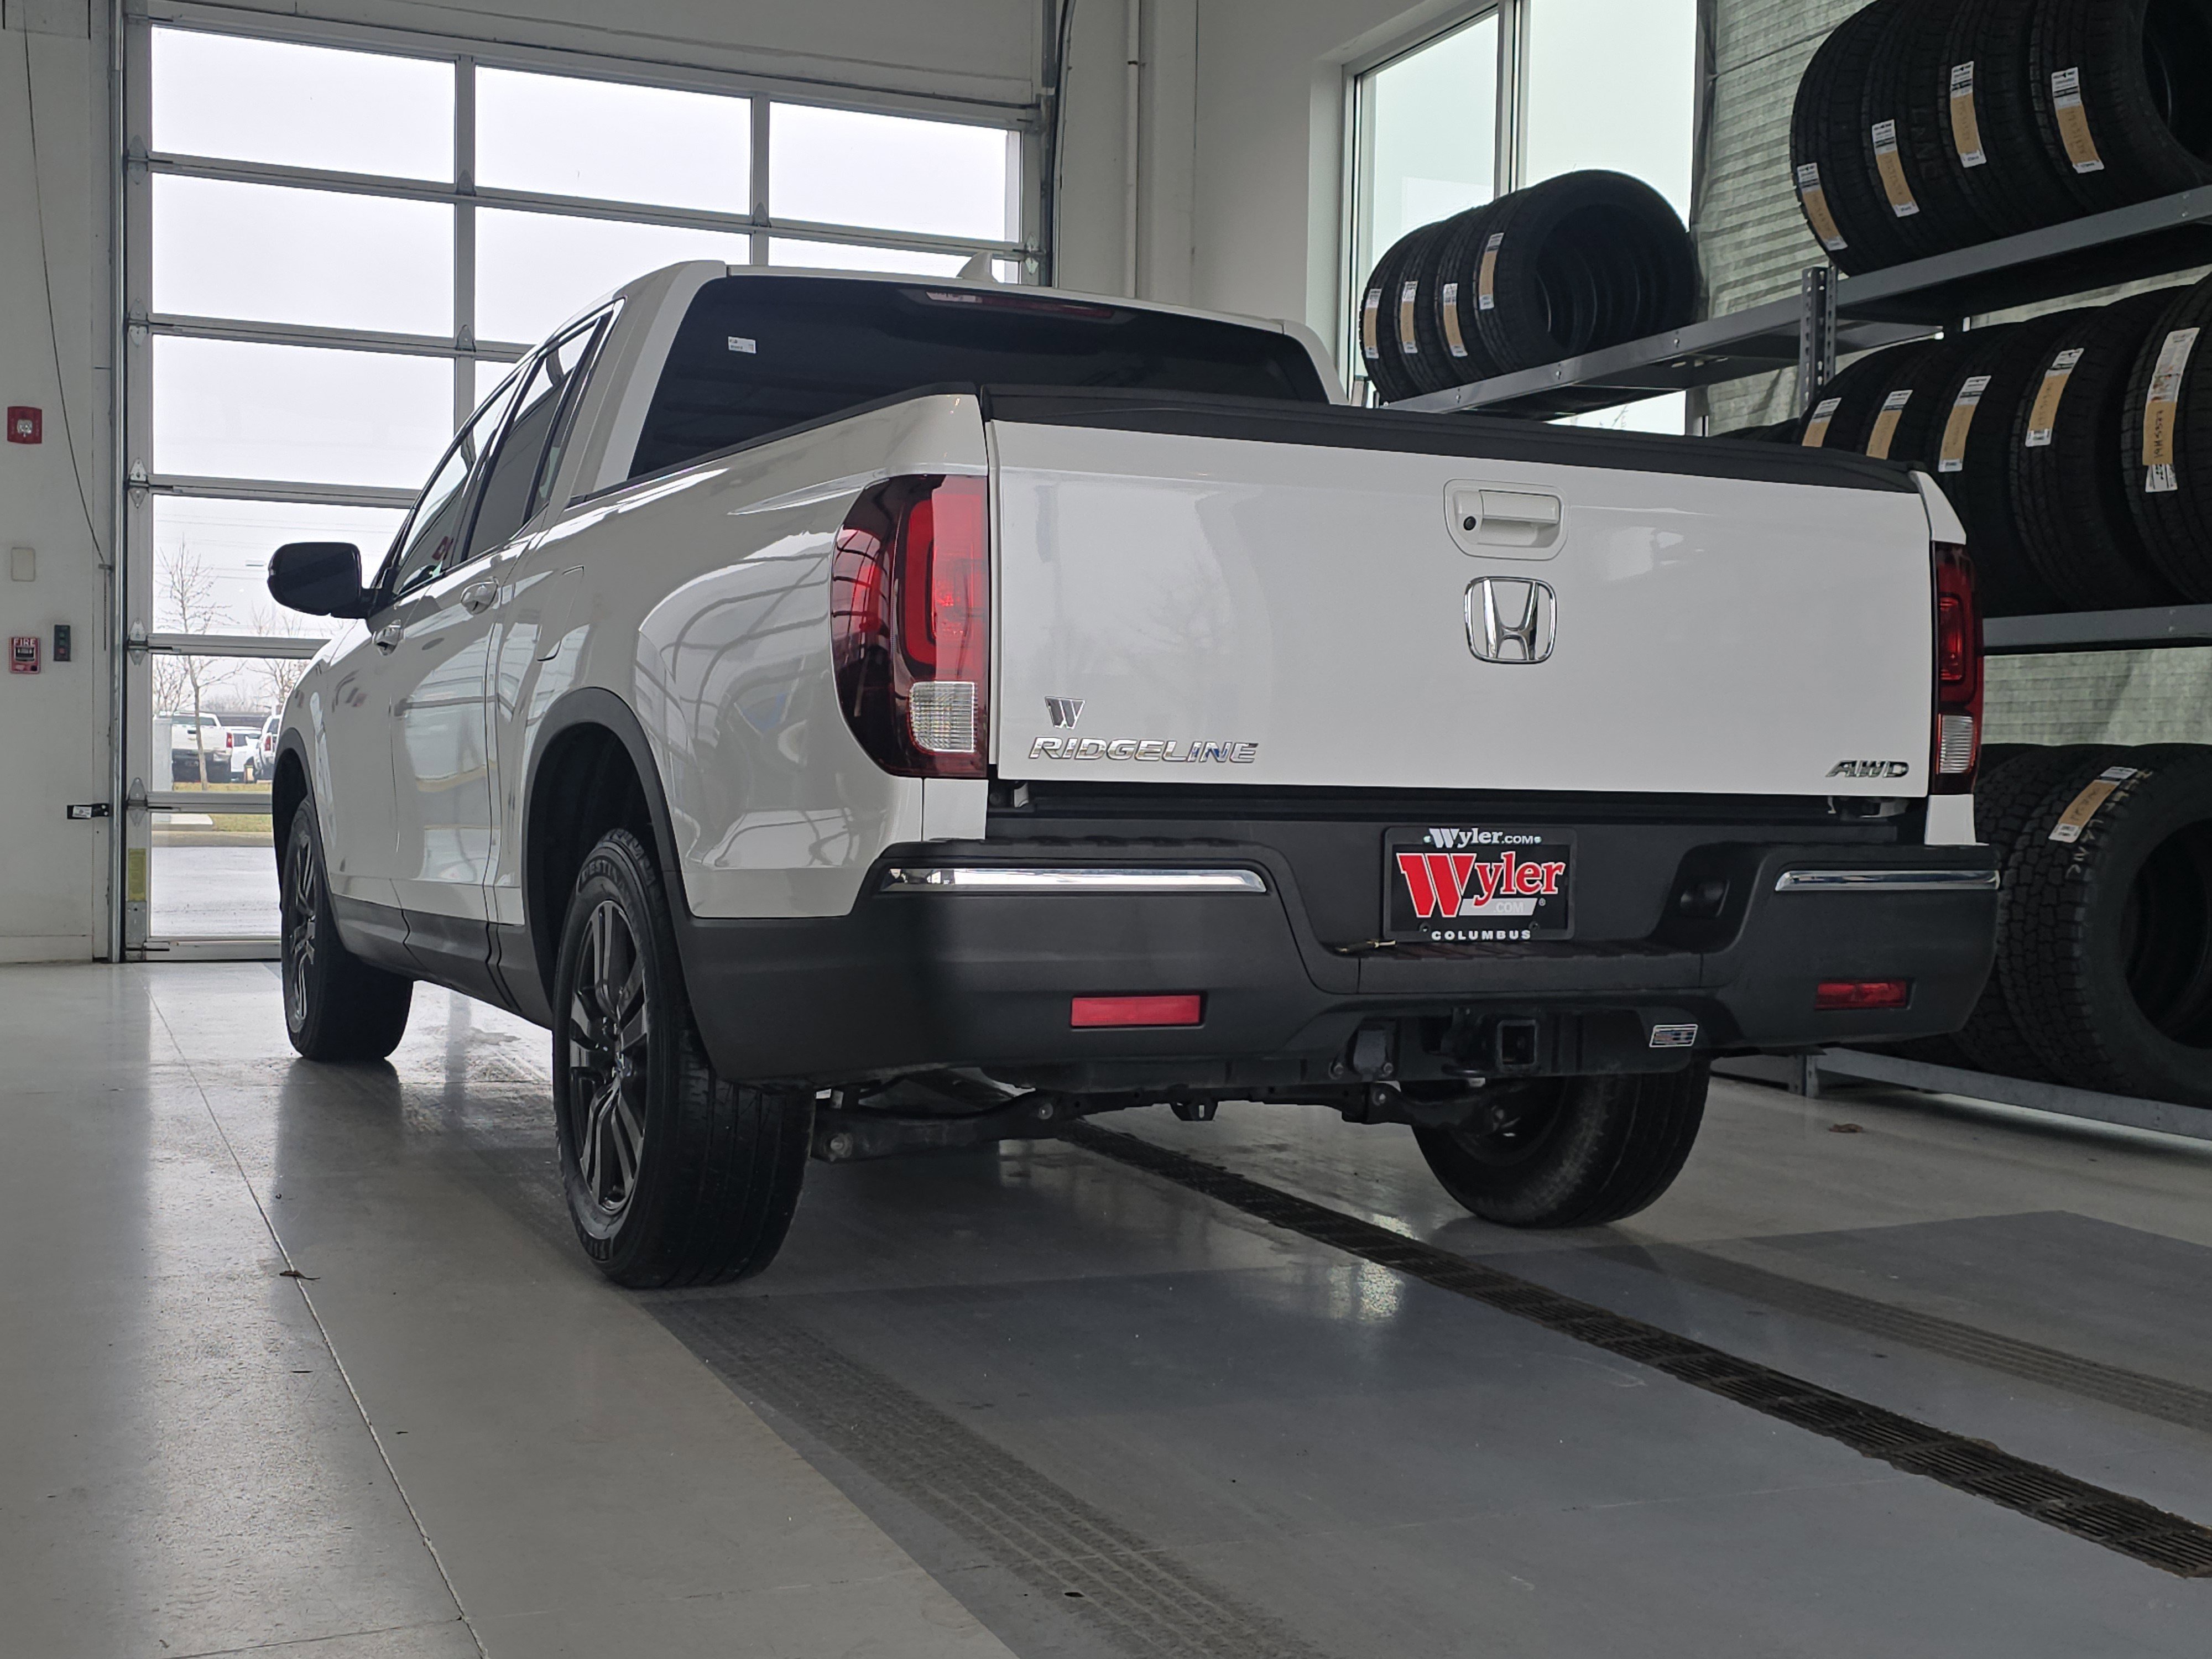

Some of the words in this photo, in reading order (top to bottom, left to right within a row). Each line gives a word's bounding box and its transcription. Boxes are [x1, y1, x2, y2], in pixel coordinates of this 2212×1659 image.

[13, 638, 35, 646] FIRE
[1028, 736, 1259, 763] RIDGELINE
[1825, 760, 1910, 778] AWD
[1396, 851, 1566, 918] Wyler
[1431, 929, 1531, 940] COLUMBUS
